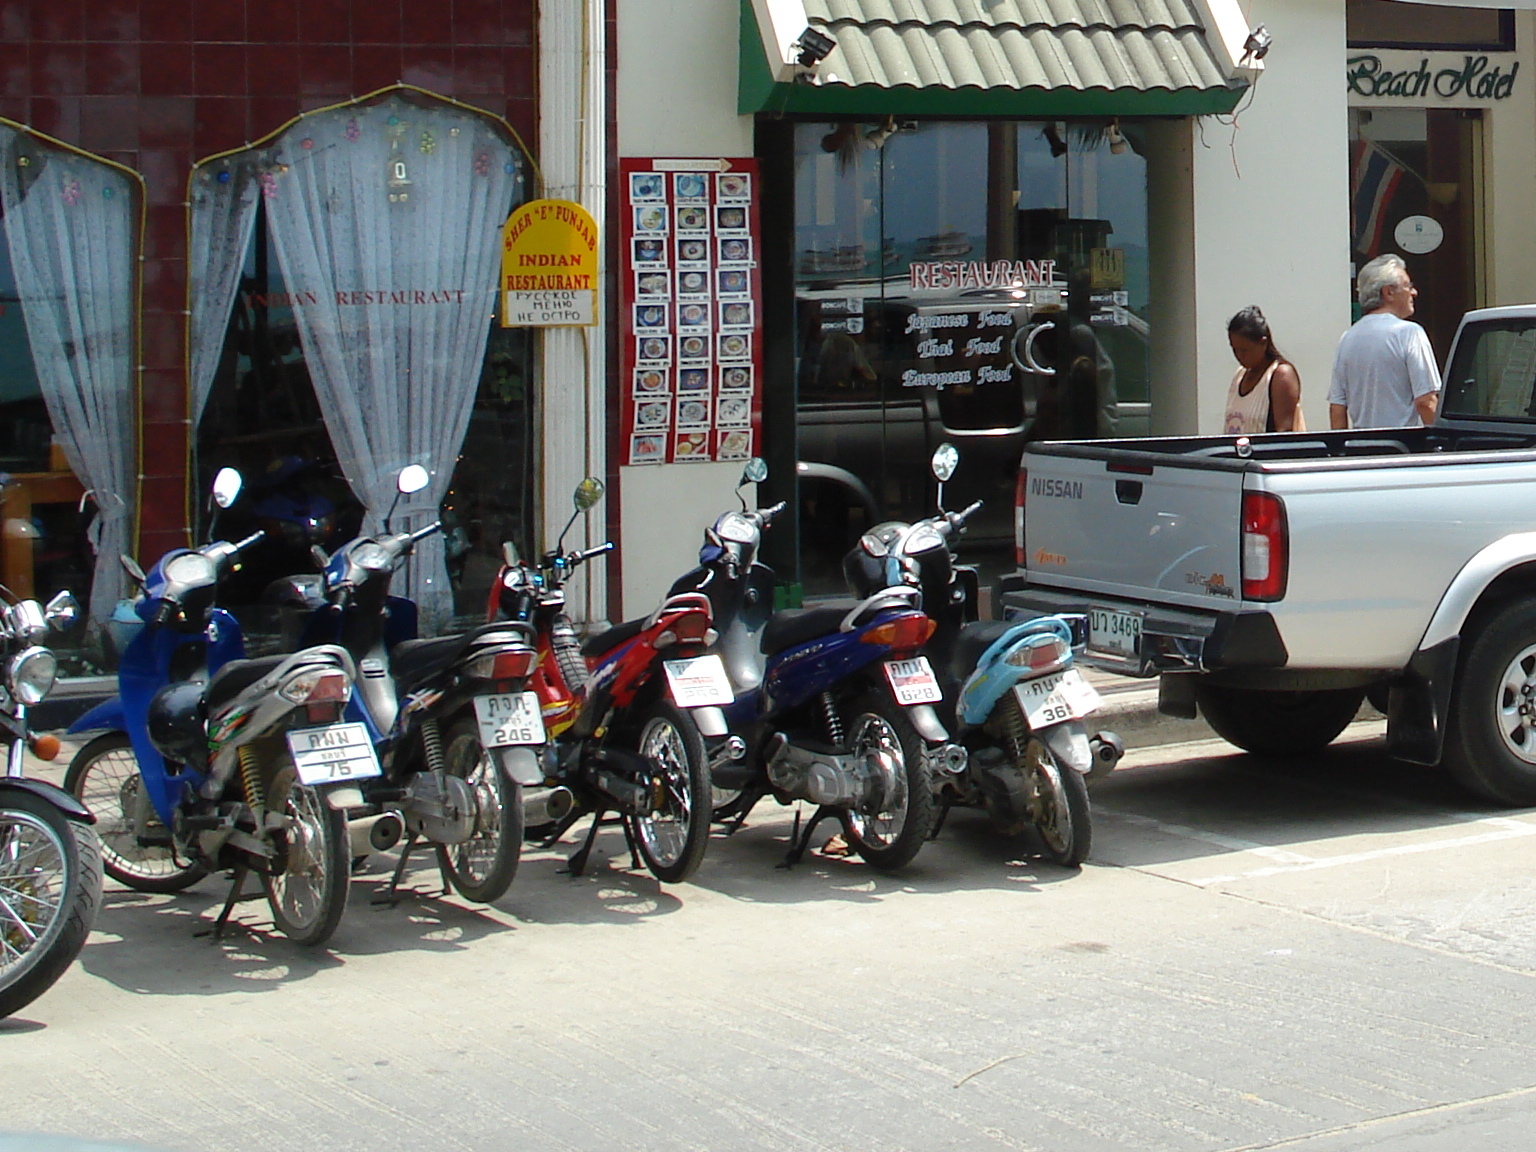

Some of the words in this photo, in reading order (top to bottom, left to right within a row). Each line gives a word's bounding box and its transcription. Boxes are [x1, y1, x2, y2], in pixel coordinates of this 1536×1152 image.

[1347, 55, 1432, 97] Beach
[1434, 56, 1520, 100] Hotel
[505, 213, 532, 251] SHER
[556, 205, 596, 251] PUNJAB
[518, 254, 582, 266] INDIAN
[507, 274, 590, 290] RESTAURANT
[909, 259, 1056, 290] RESTAURANT
[336, 289, 466, 305] RESTAURANT
[517, 312, 534, 322] НЕ
[904, 313, 969, 334] Japanese
[977, 309, 1015, 329] Food
[917, 338, 954, 359] Thai
[965, 335, 1004, 357] Food
[901, 369, 972, 391] European
[976, 362, 1014, 385] Food
[1031, 478, 1083, 500] NISSAN
[1111, 614, 1139, 637] 3469
[494, 728, 532, 744] 246
[323, 761, 352, 778] 75
